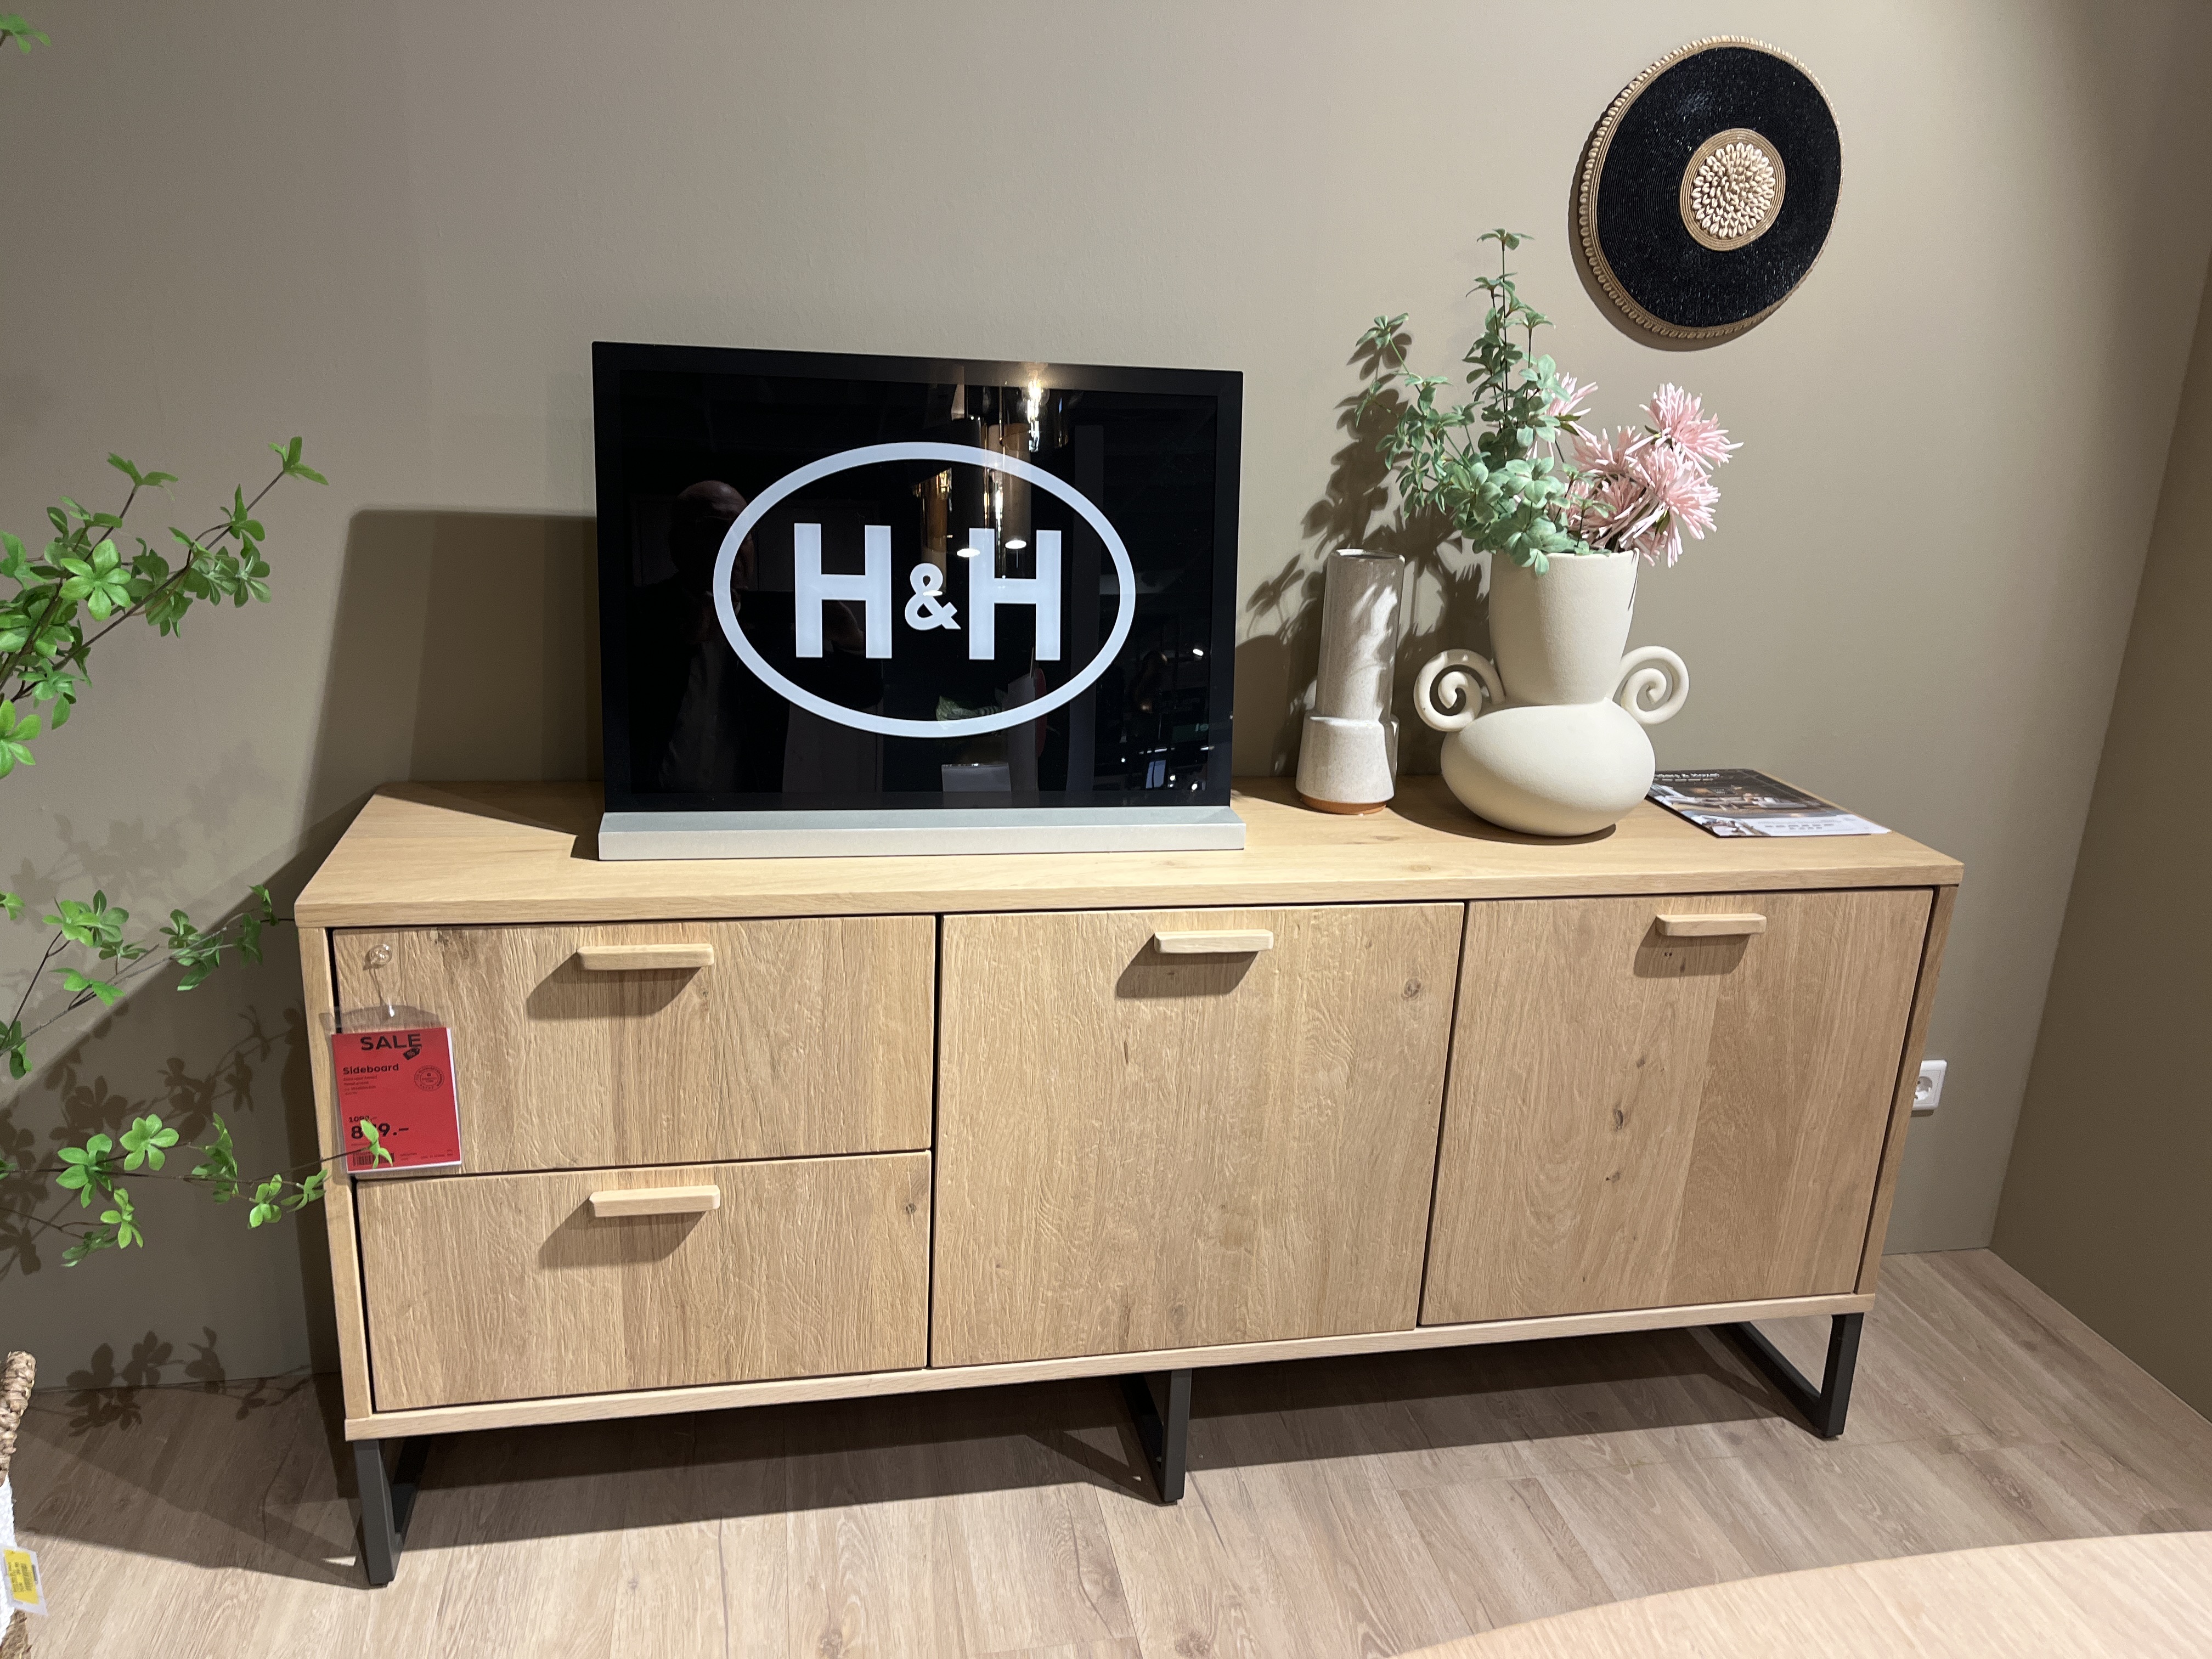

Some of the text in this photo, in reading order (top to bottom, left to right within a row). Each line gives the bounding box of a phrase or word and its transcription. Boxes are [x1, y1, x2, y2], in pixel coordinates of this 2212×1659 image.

[794, 523, 1062, 661] H&H
[360, 1034, 422, 1050] SALE
[343, 1063, 399, 1075] Sideboard
[351, 1122, 409, 1139] 89.-
